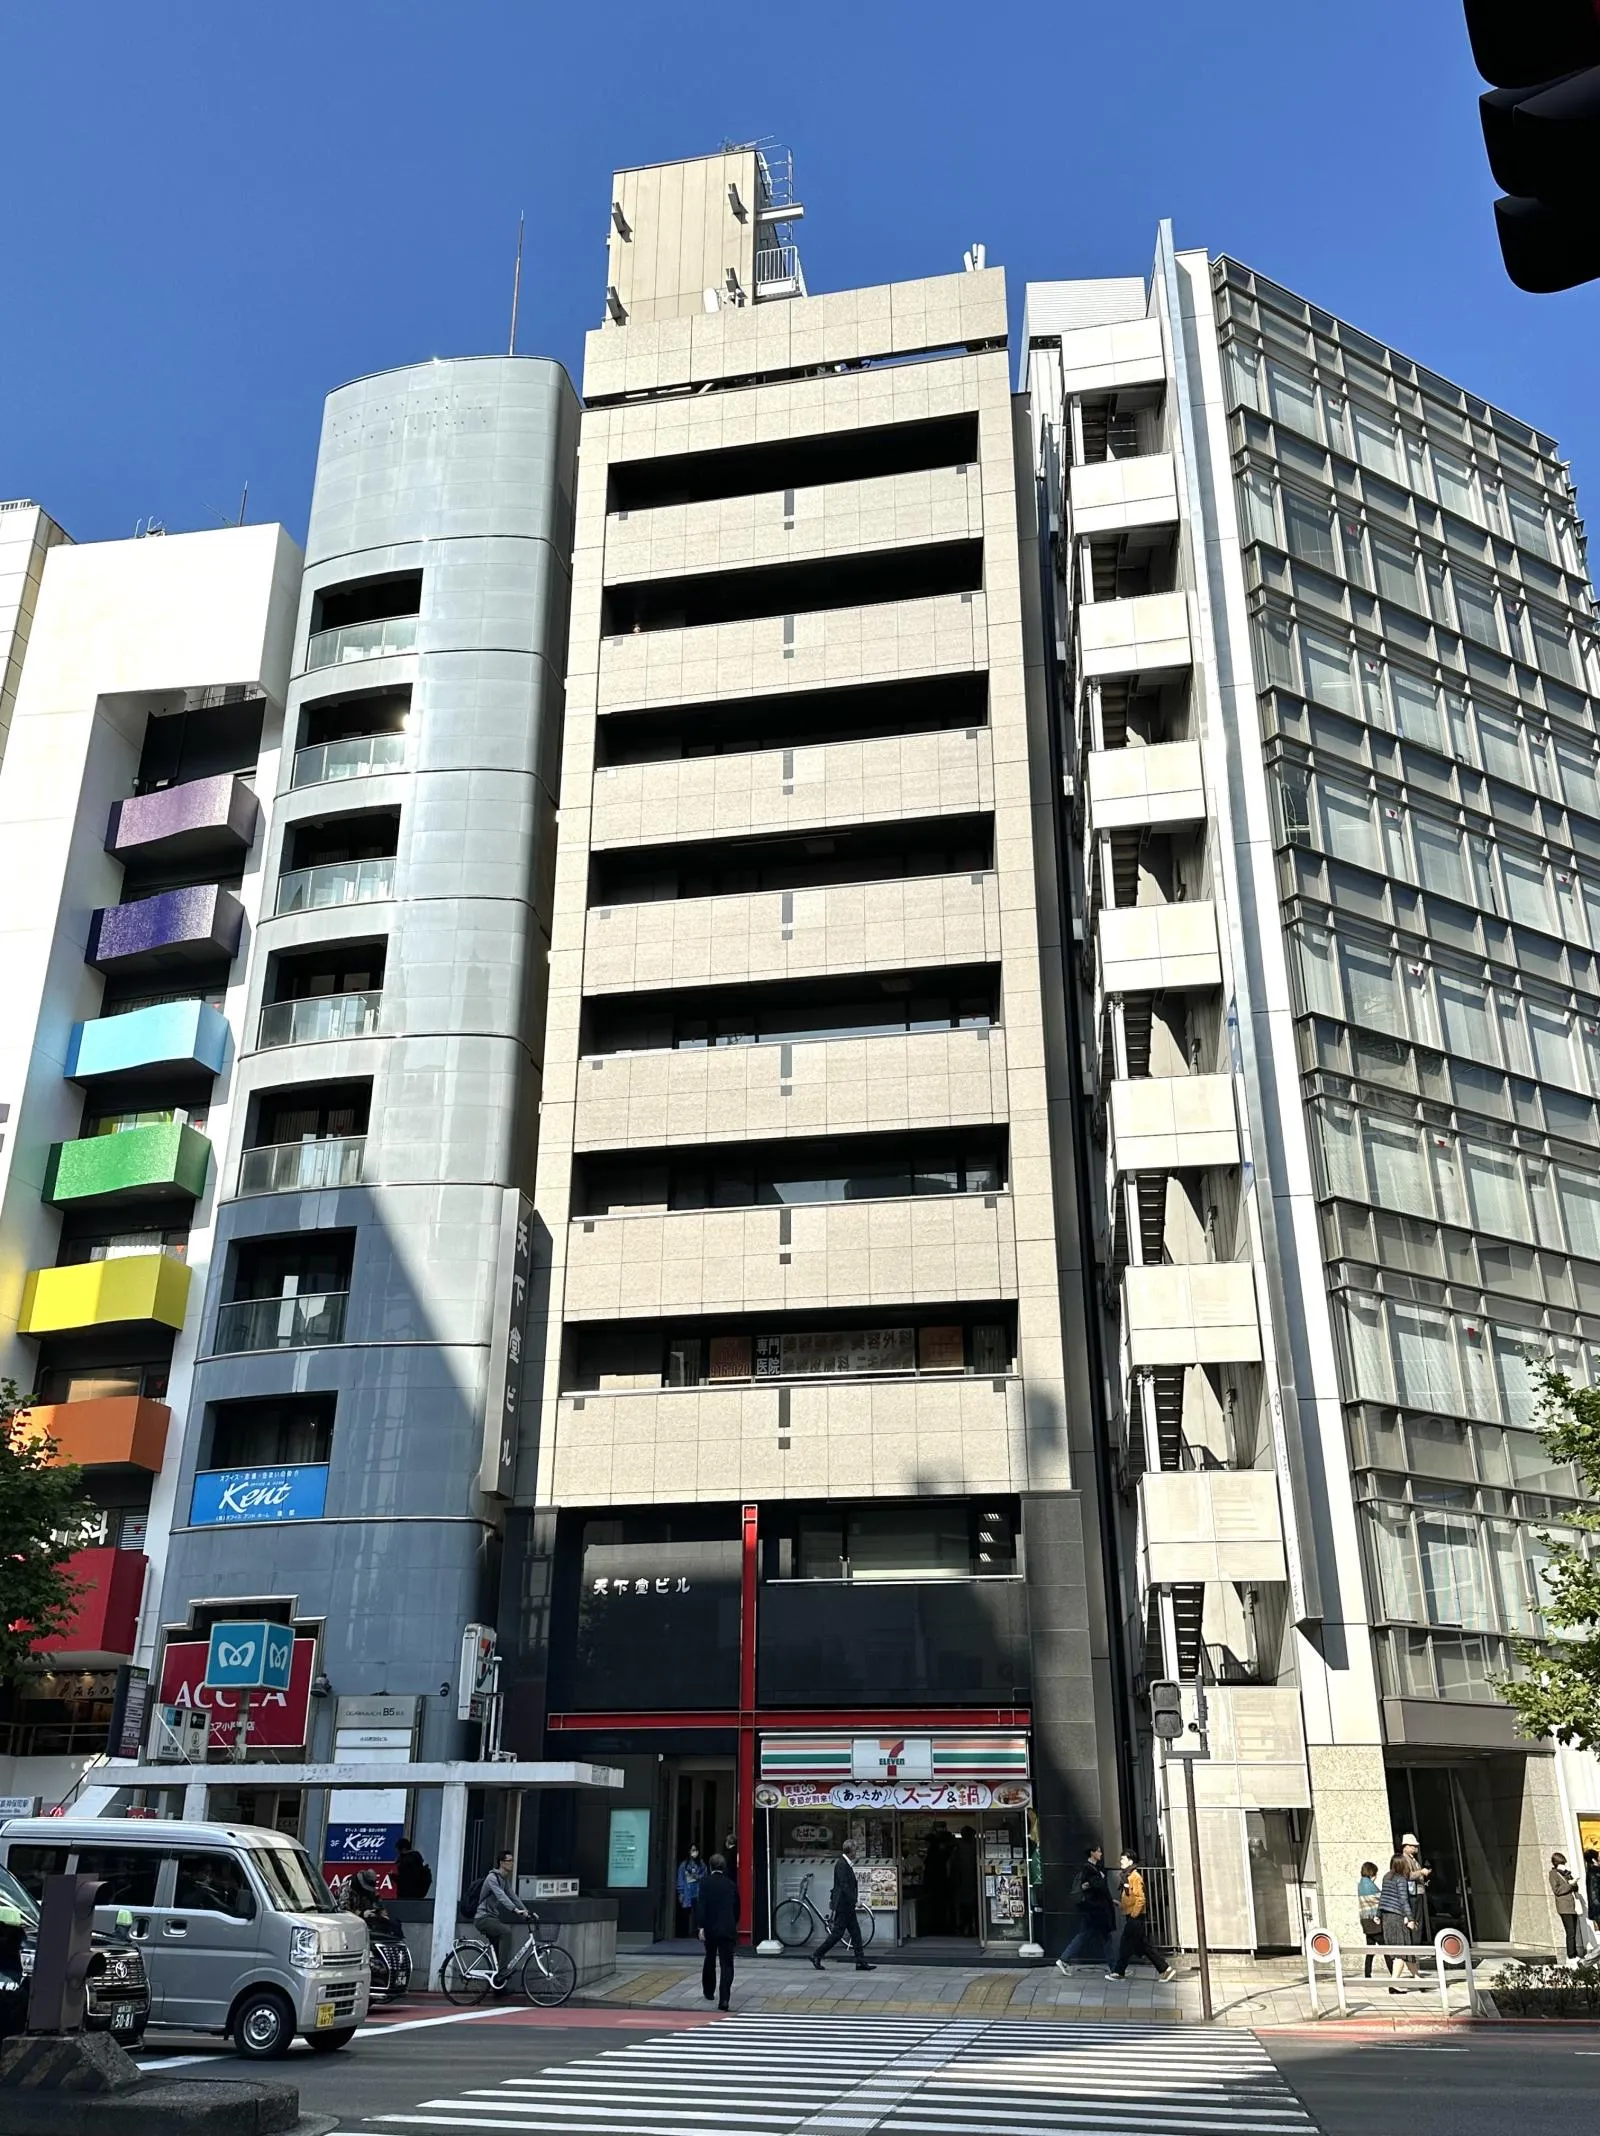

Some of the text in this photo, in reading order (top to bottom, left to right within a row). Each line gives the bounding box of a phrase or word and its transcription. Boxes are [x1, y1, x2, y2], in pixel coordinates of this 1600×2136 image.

[757, 1336, 780, 1355] 専門
[757, 1357, 780, 1375] 医院
[218, 1482, 292, 1513] Kent
[593, 1577, 691, 1596] 天下堂ビル
[73, 1686, 115, 1697] みちの
[383, 1707, 395, 1716] B5
[843, 1787, 883, 1801] あったか
[342, 1833, 386, 1851] Kent
